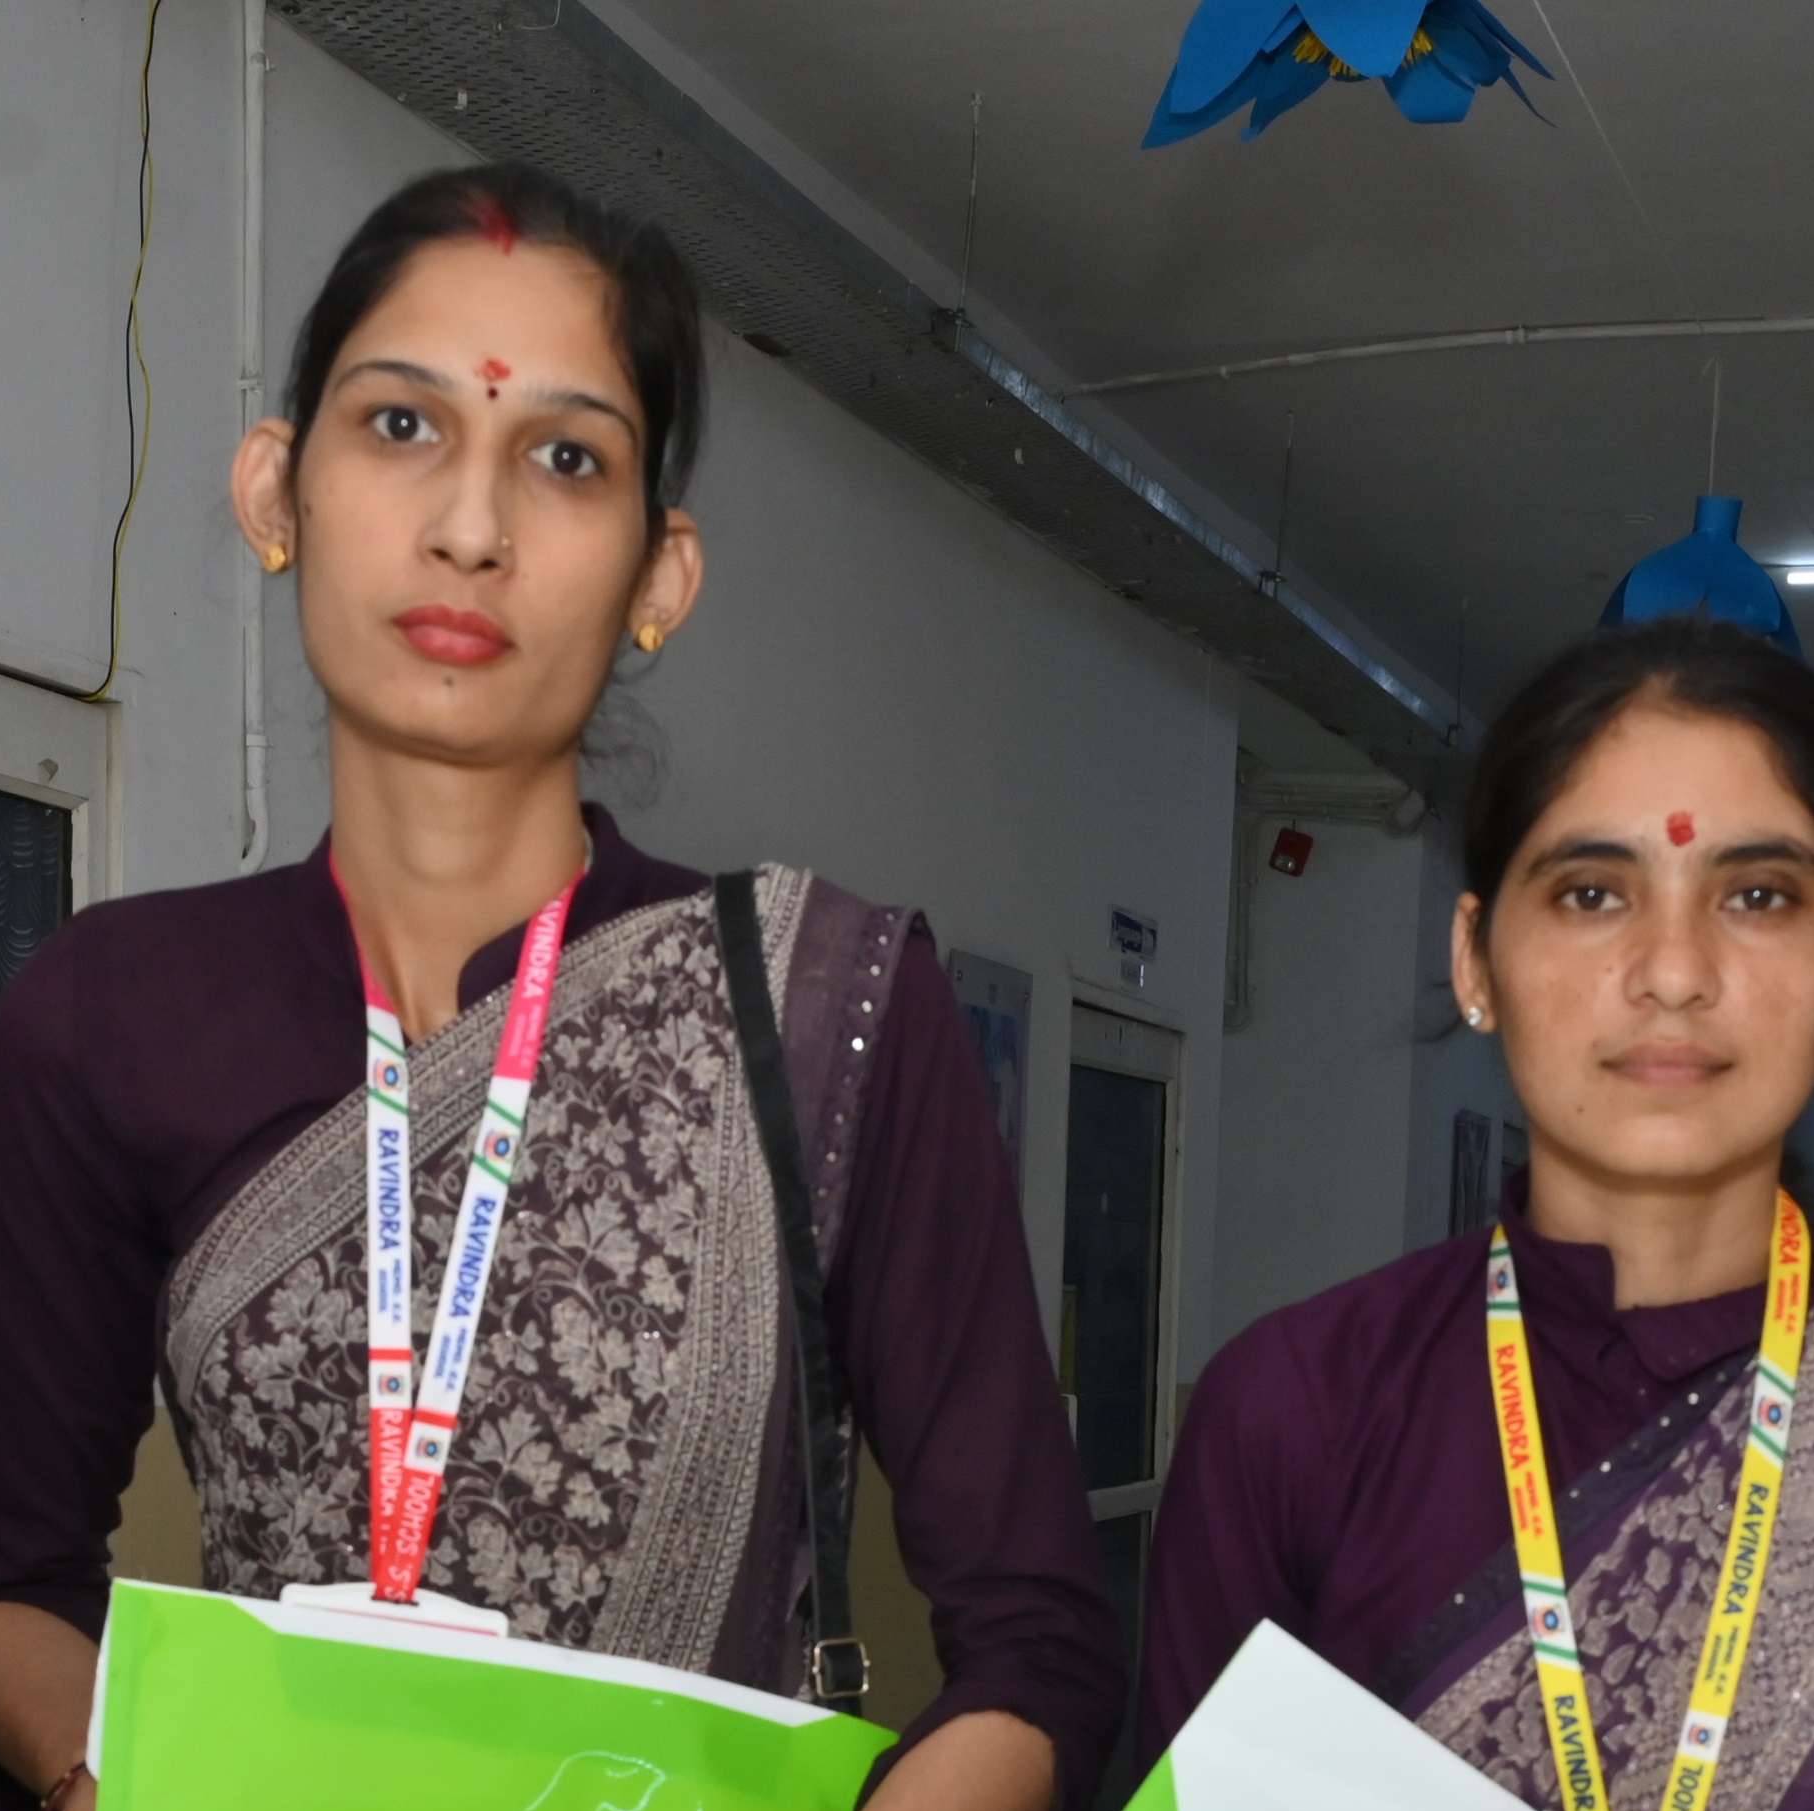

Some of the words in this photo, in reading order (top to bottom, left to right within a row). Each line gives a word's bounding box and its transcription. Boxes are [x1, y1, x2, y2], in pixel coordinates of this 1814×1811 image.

[523, 899, 562, 999] VINDRA
[377, 1128, 402, 1251] RAVINDRA
[448, 1197, 497, 1318] RAVINDRA
[1495, 1343, 1530, 1470] RAVINDRA
[395, 1475, 436, 1557] SCHOOL
[1722, 1482, 1769, 1616] RAVINDRA
